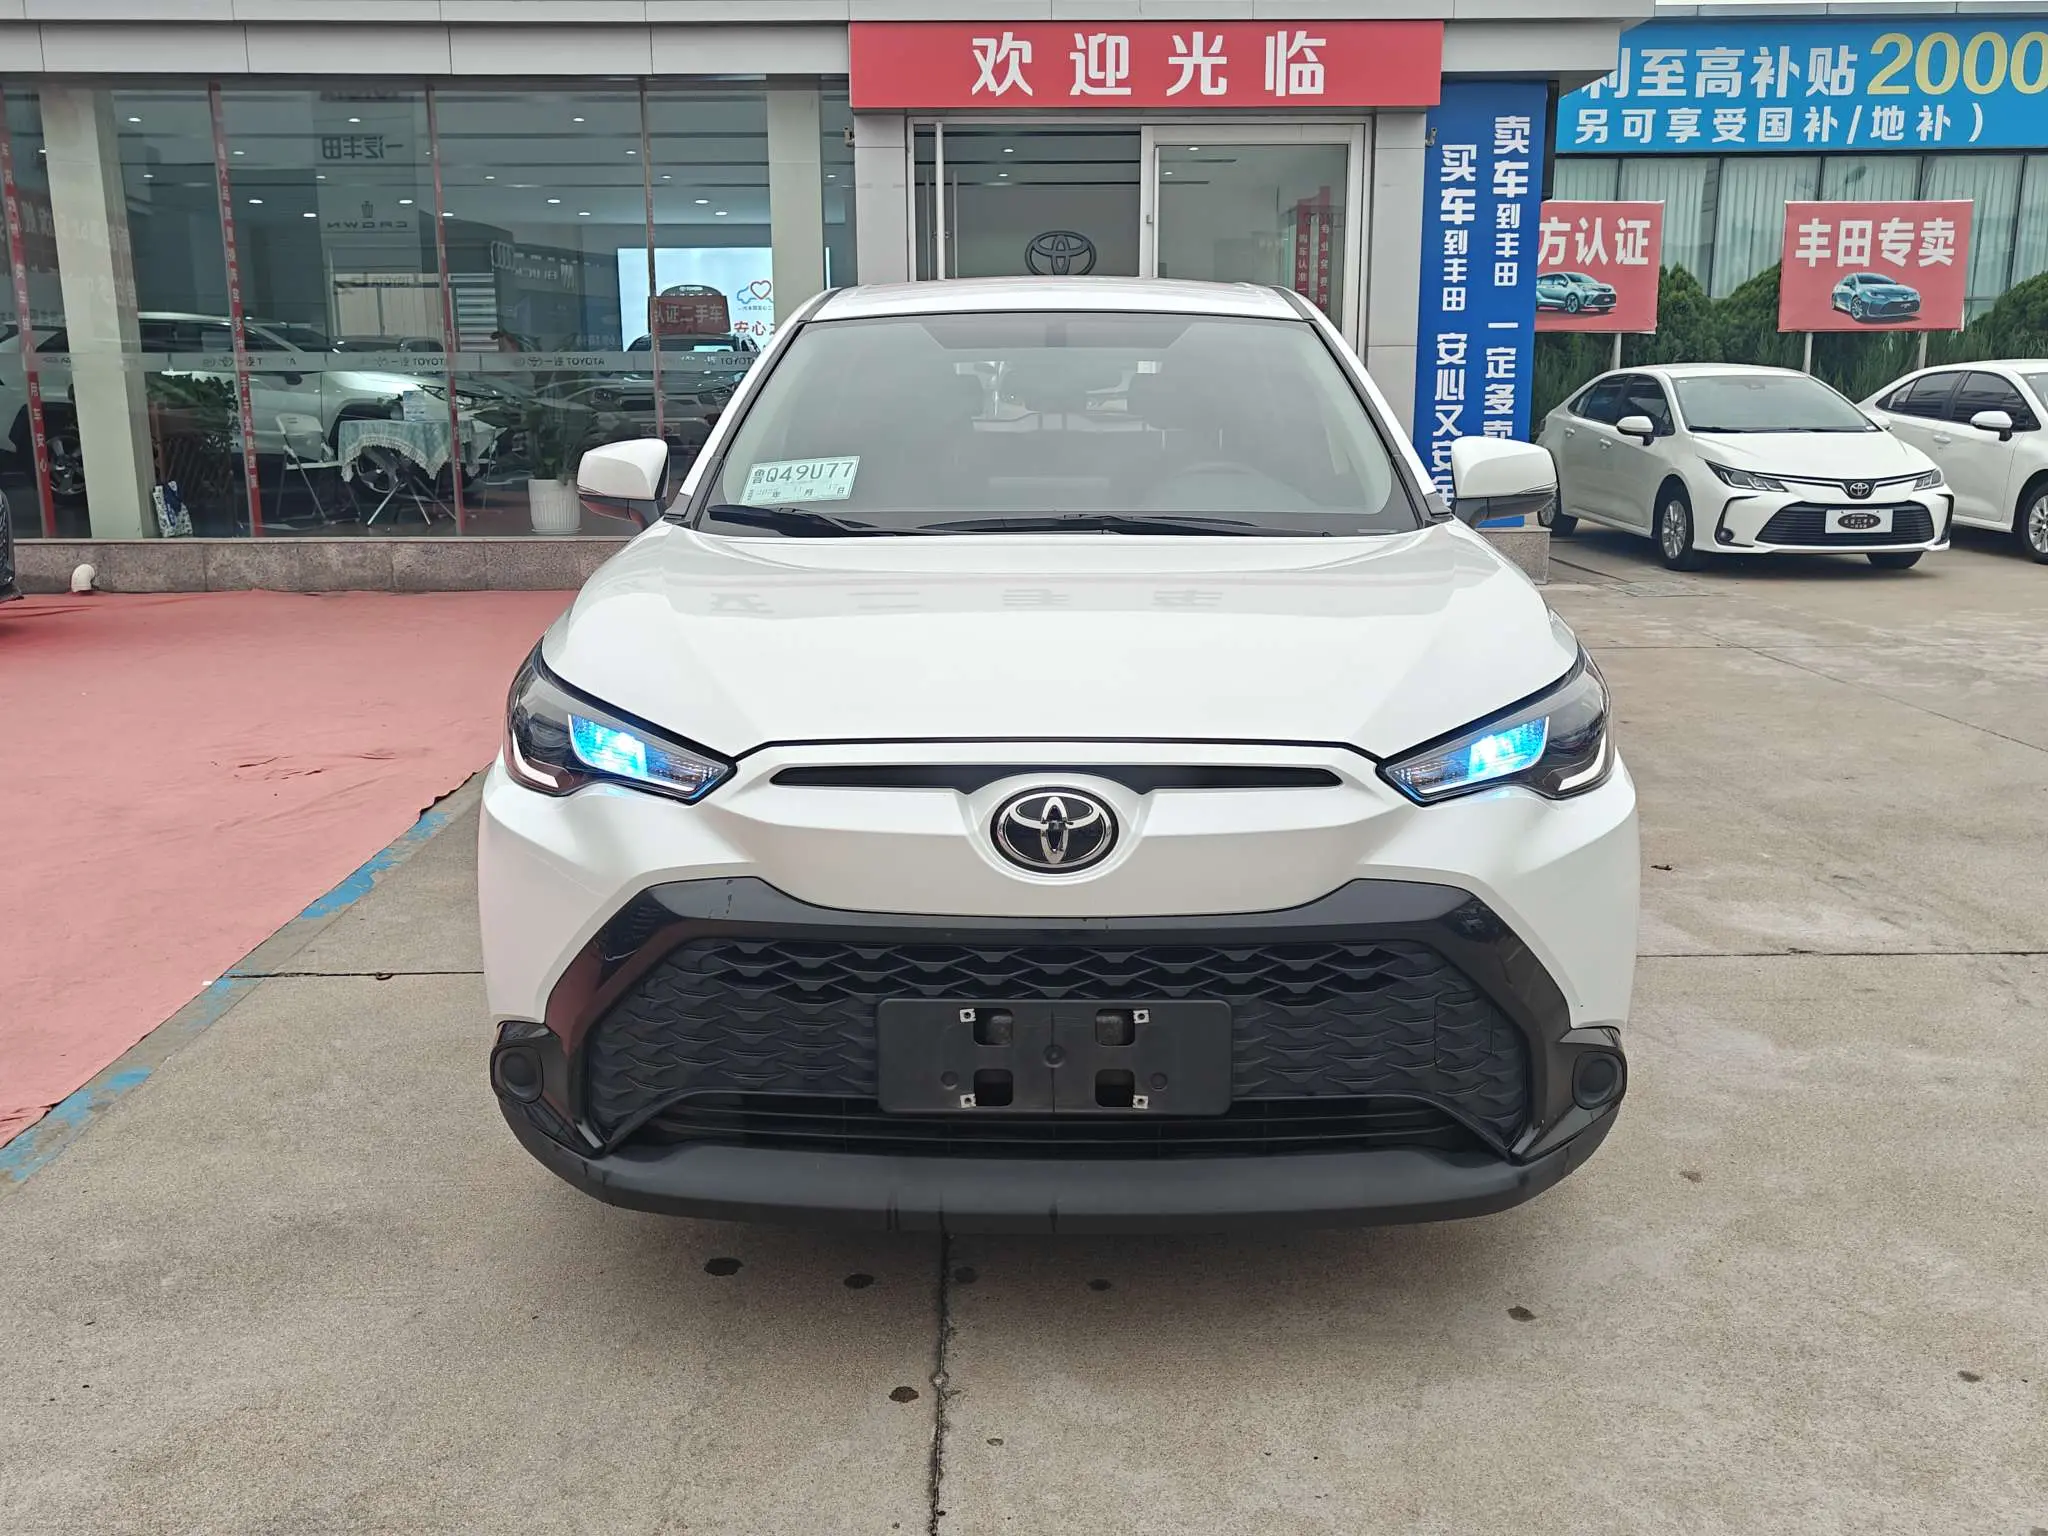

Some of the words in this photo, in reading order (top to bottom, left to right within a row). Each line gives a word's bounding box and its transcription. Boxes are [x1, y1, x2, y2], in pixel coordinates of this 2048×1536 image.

[972, 31, 1326, 96] 欢迎光临
[1493, 116, 1530, 287] 卖车到丰田
[1440, 144, 1477, 312] 买车到丰田
[1537, 217, 1651, 266] 方认证
[1795, 217, 1956, 268] 丰田专卖
[413, 357, 449, 366] TOYOT
[567, 357, 605, 366] TOYOTA
[720, 357, 757, 366] TOYOT
[752, 462, 855, 484] 鲁Q49U77
